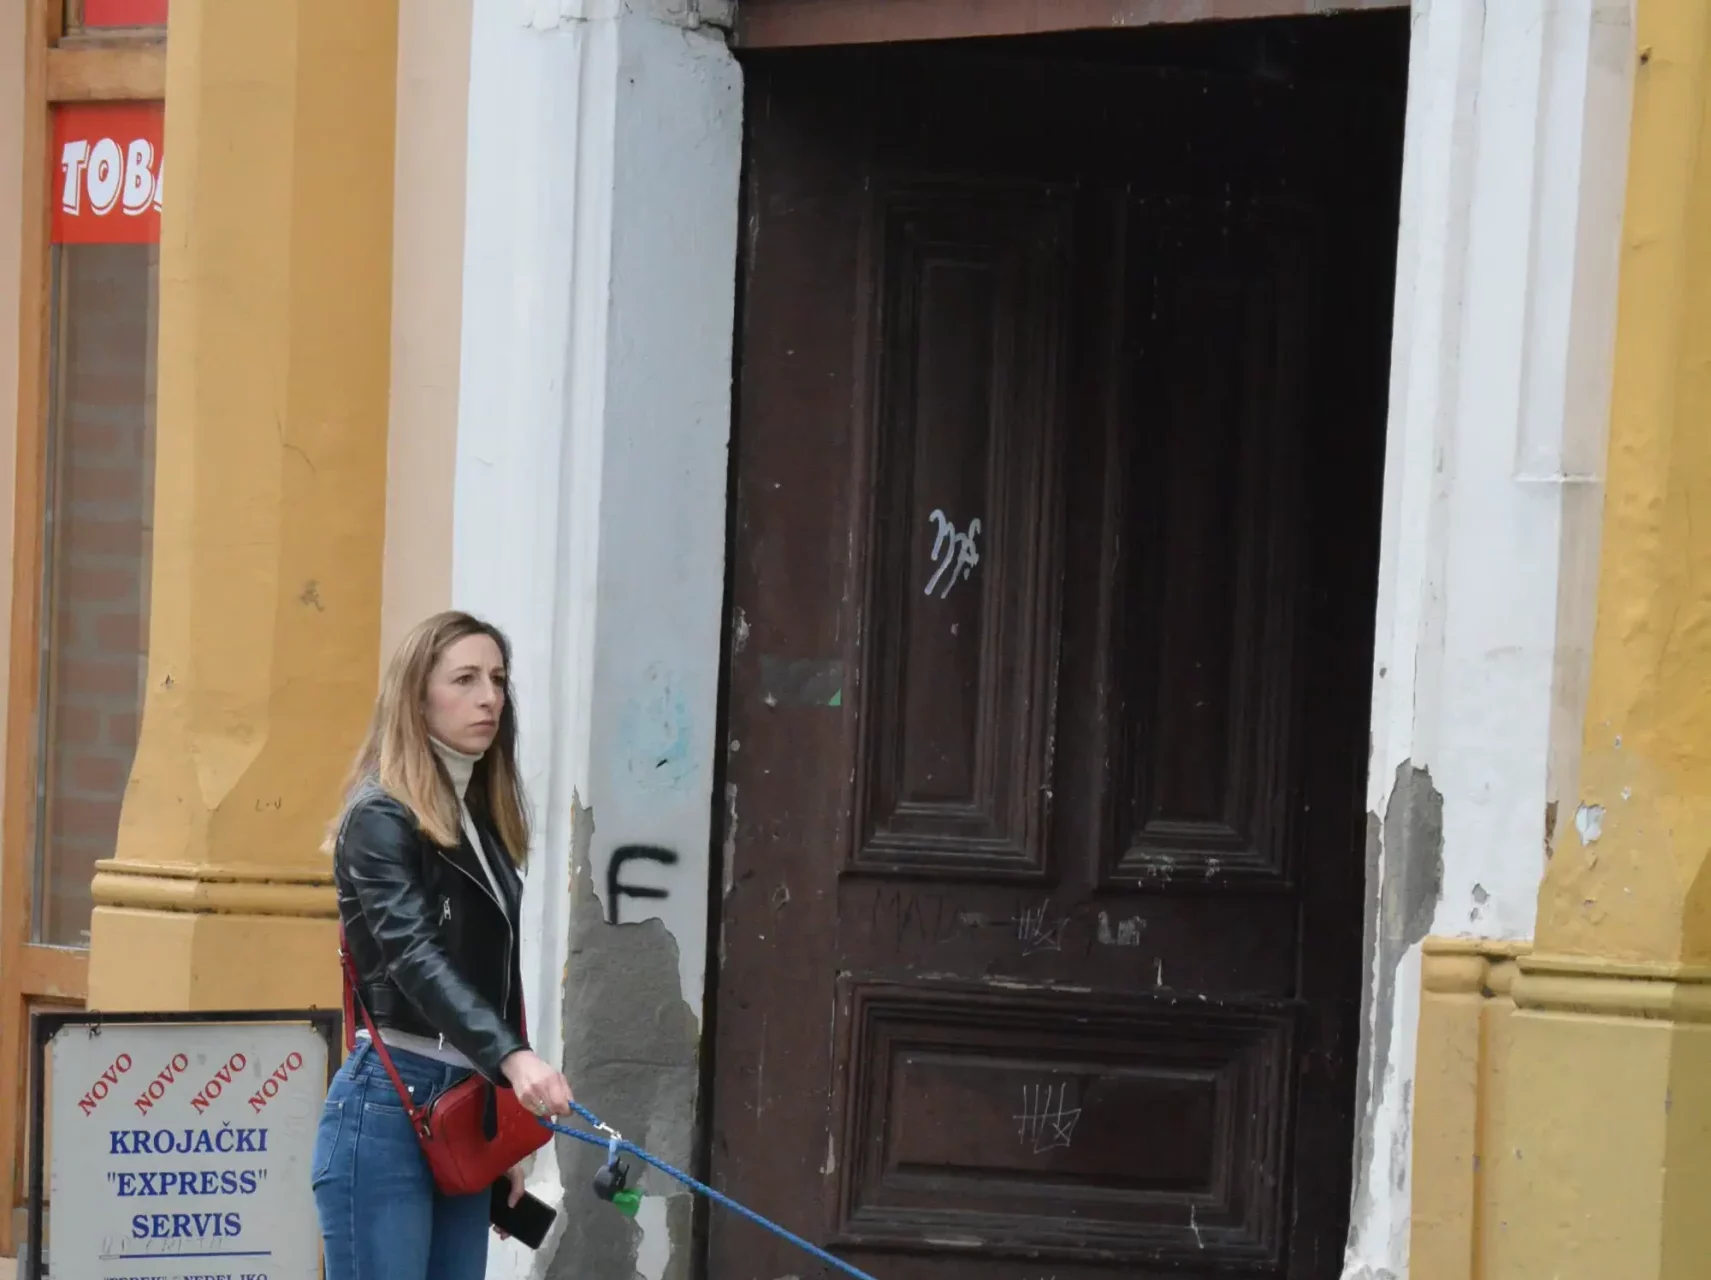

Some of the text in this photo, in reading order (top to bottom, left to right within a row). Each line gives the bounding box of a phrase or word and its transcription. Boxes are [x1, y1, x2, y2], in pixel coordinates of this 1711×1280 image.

[78, 1053, 132, 1117] NOVO
[134, 1053, 188, 1116] NOVO
[190, 1052, 246, 1115] NOVO
[248, 1051, 302, 1114] NOVO
[109, 1121, 268, 1154] KROJAČKI
[107, 1168, 268, 1197] "EXPRESS"
[132, 1212, 242, 1238] SERVIS
